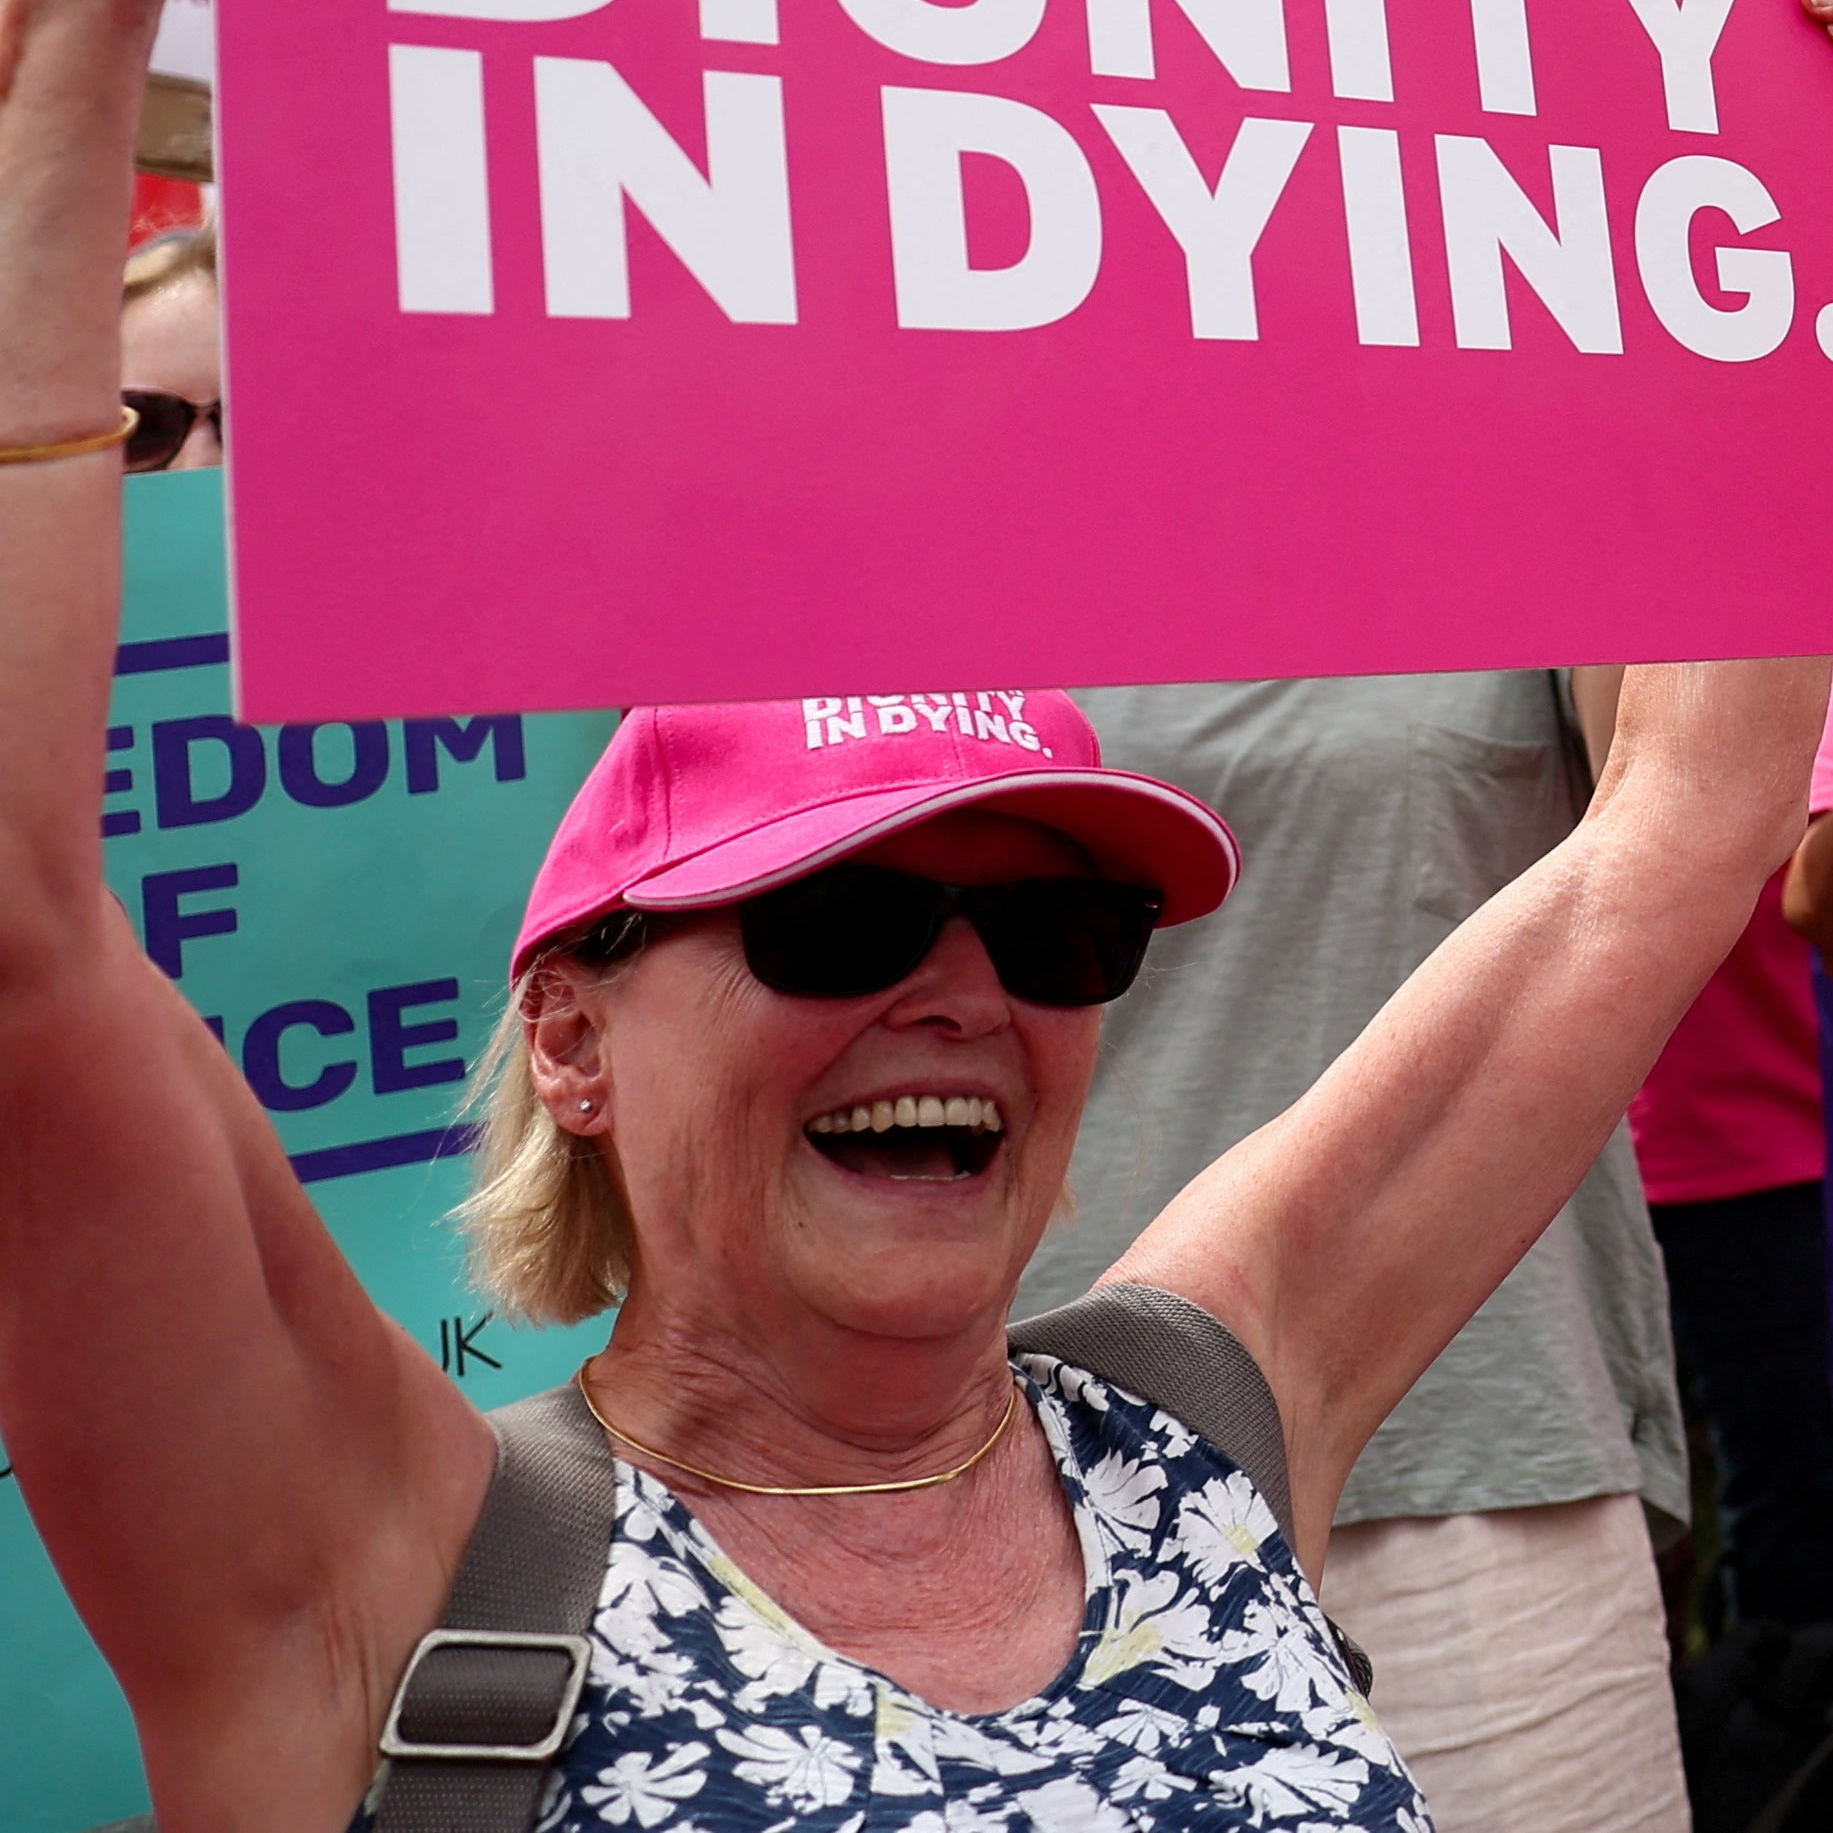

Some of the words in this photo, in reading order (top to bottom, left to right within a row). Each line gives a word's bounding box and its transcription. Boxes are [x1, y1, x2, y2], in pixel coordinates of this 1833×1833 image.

[388, 43, 800, 325] IN
[806, 712, 868, 751] IN
[876, 703, 1053, 760] DYING.
